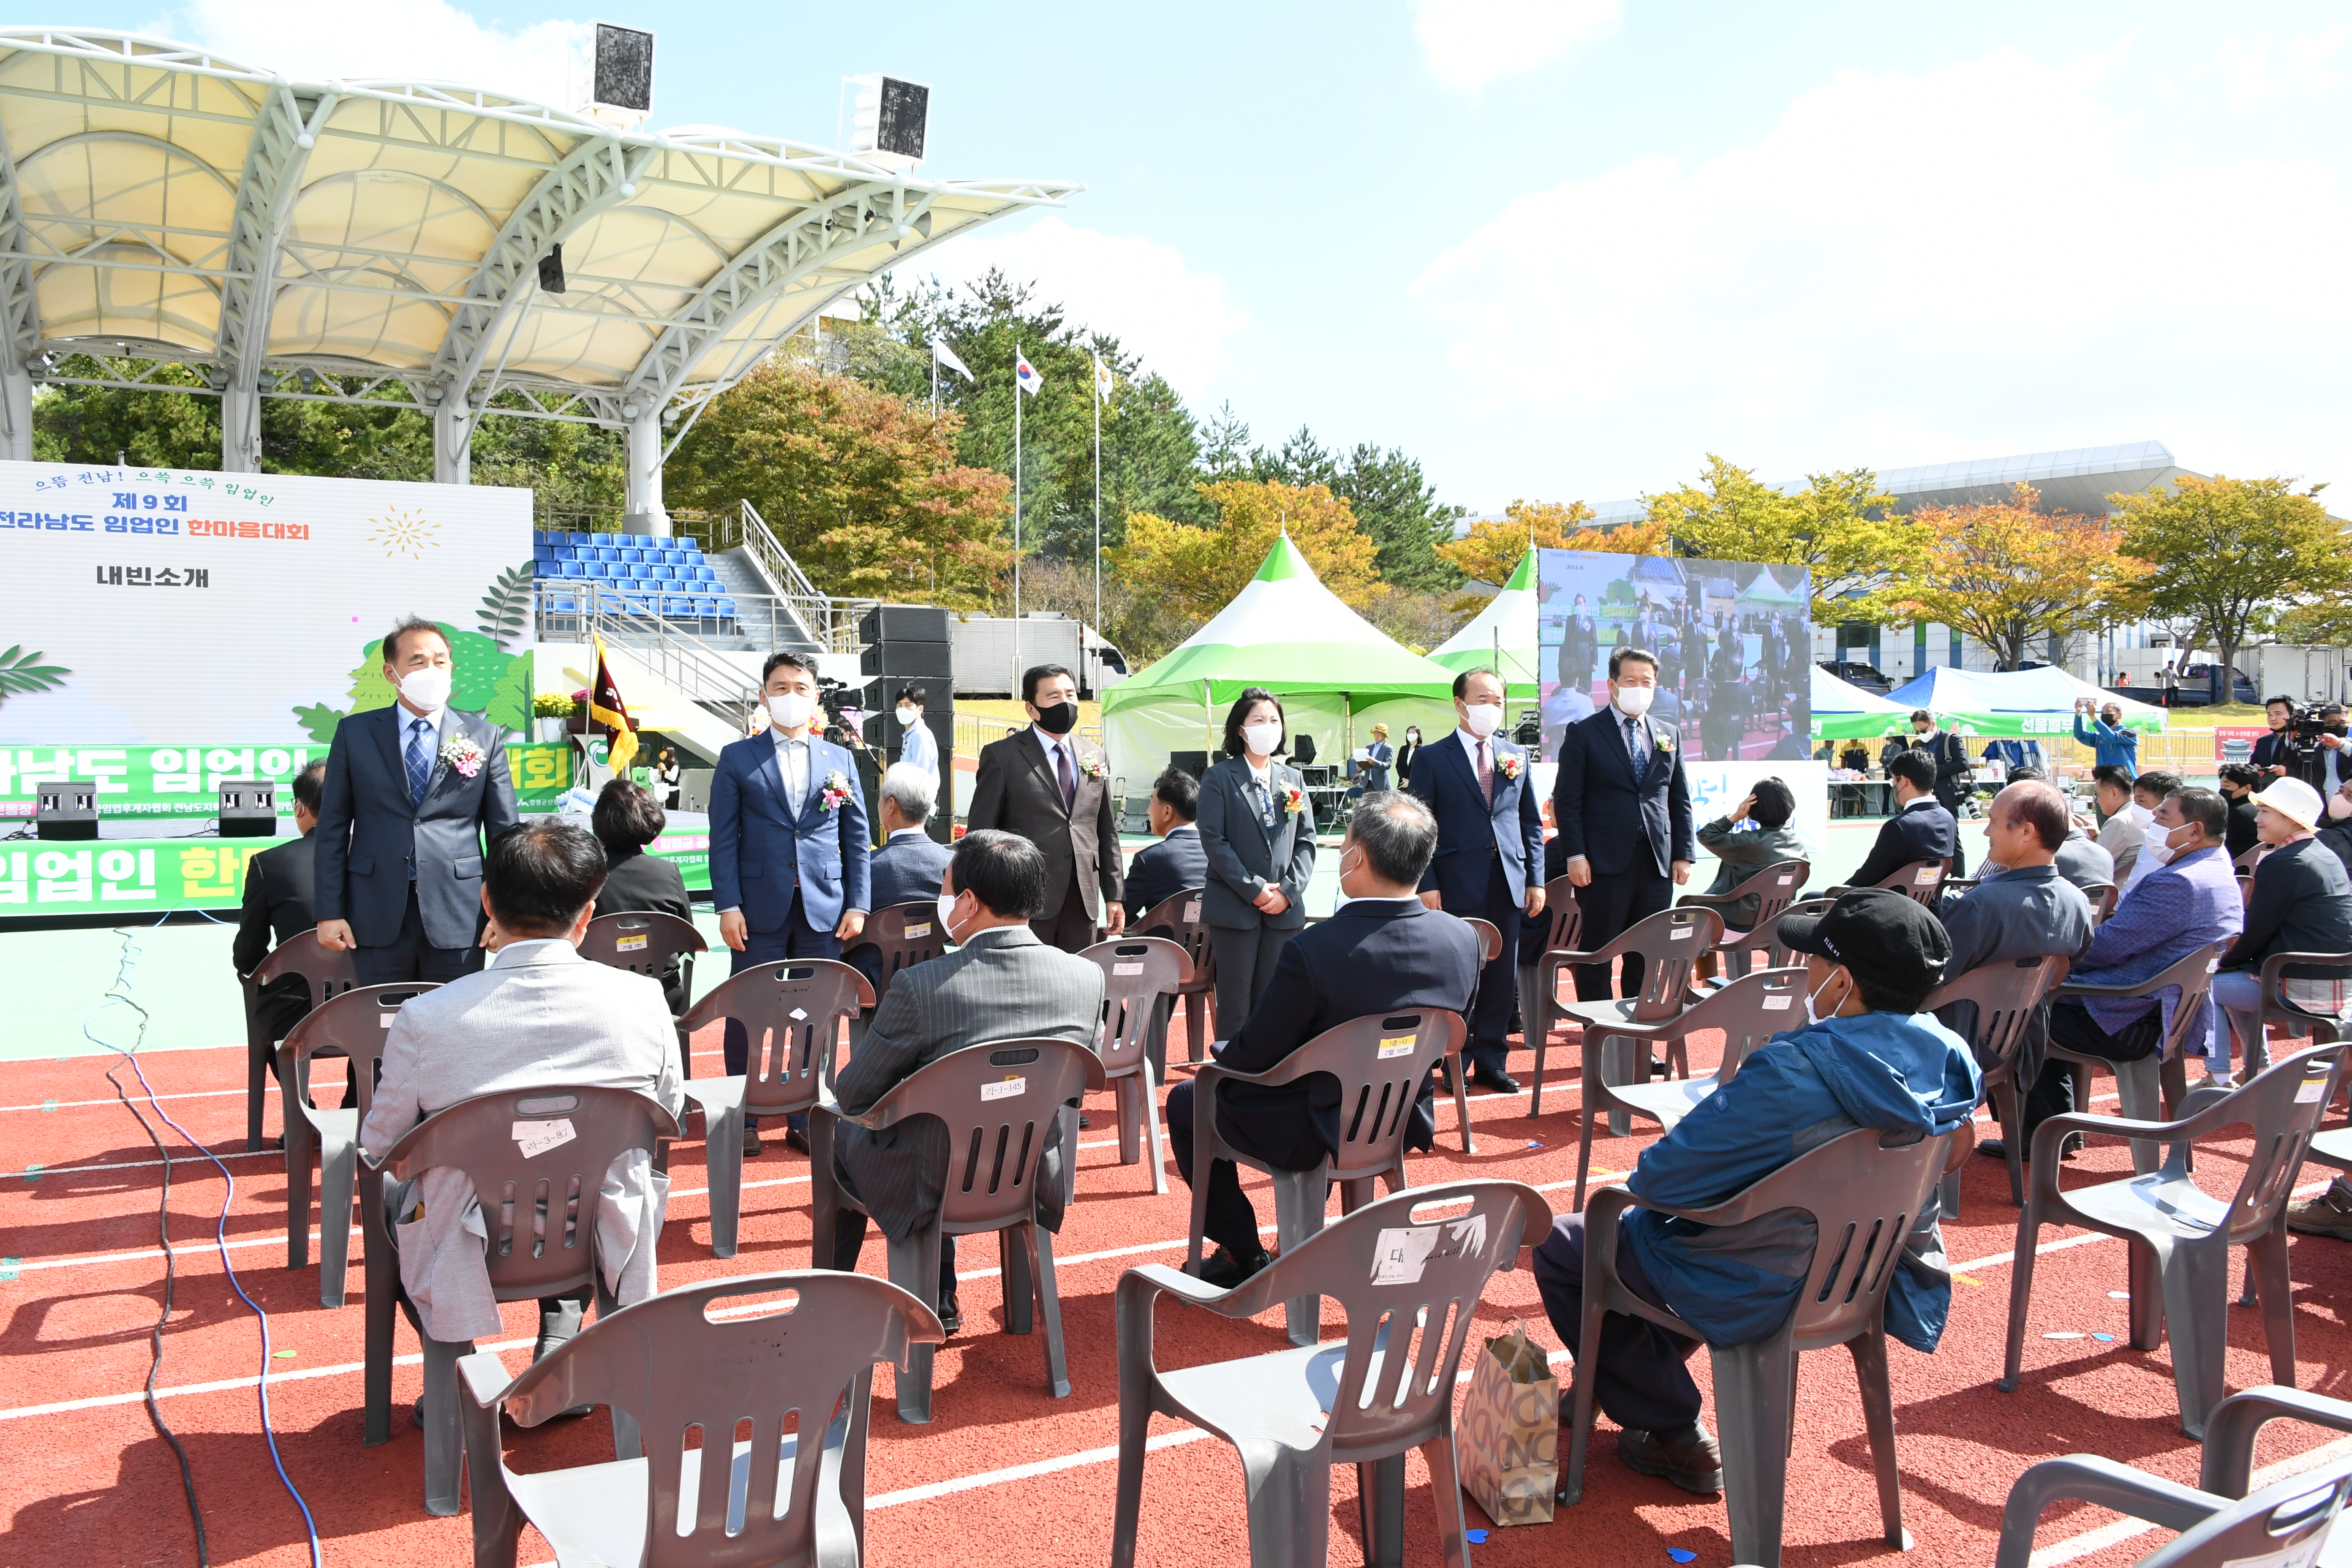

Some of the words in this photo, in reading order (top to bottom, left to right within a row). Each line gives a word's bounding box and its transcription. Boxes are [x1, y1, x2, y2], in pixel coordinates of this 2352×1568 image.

[35, 476, 68, 491] 으뜸
[78, 471, 123, 485] 전남!
[136, 472, 171, 484] 으쓱
[180, 476, 215, 490] 으쓱
[226, 484, 274, 507] 임업인
[104, 516, 179, 535] 임업인
[187, 520, 309, 540] 한마음대회
[97, 566, 208, 588] 내빈소개
[0, 749, 128, 795] 남도
[660, 837, 694, 850] 함평군
[697, 837, 709, 849] 공
[660, 855, 702, 864] 업후계자협회
